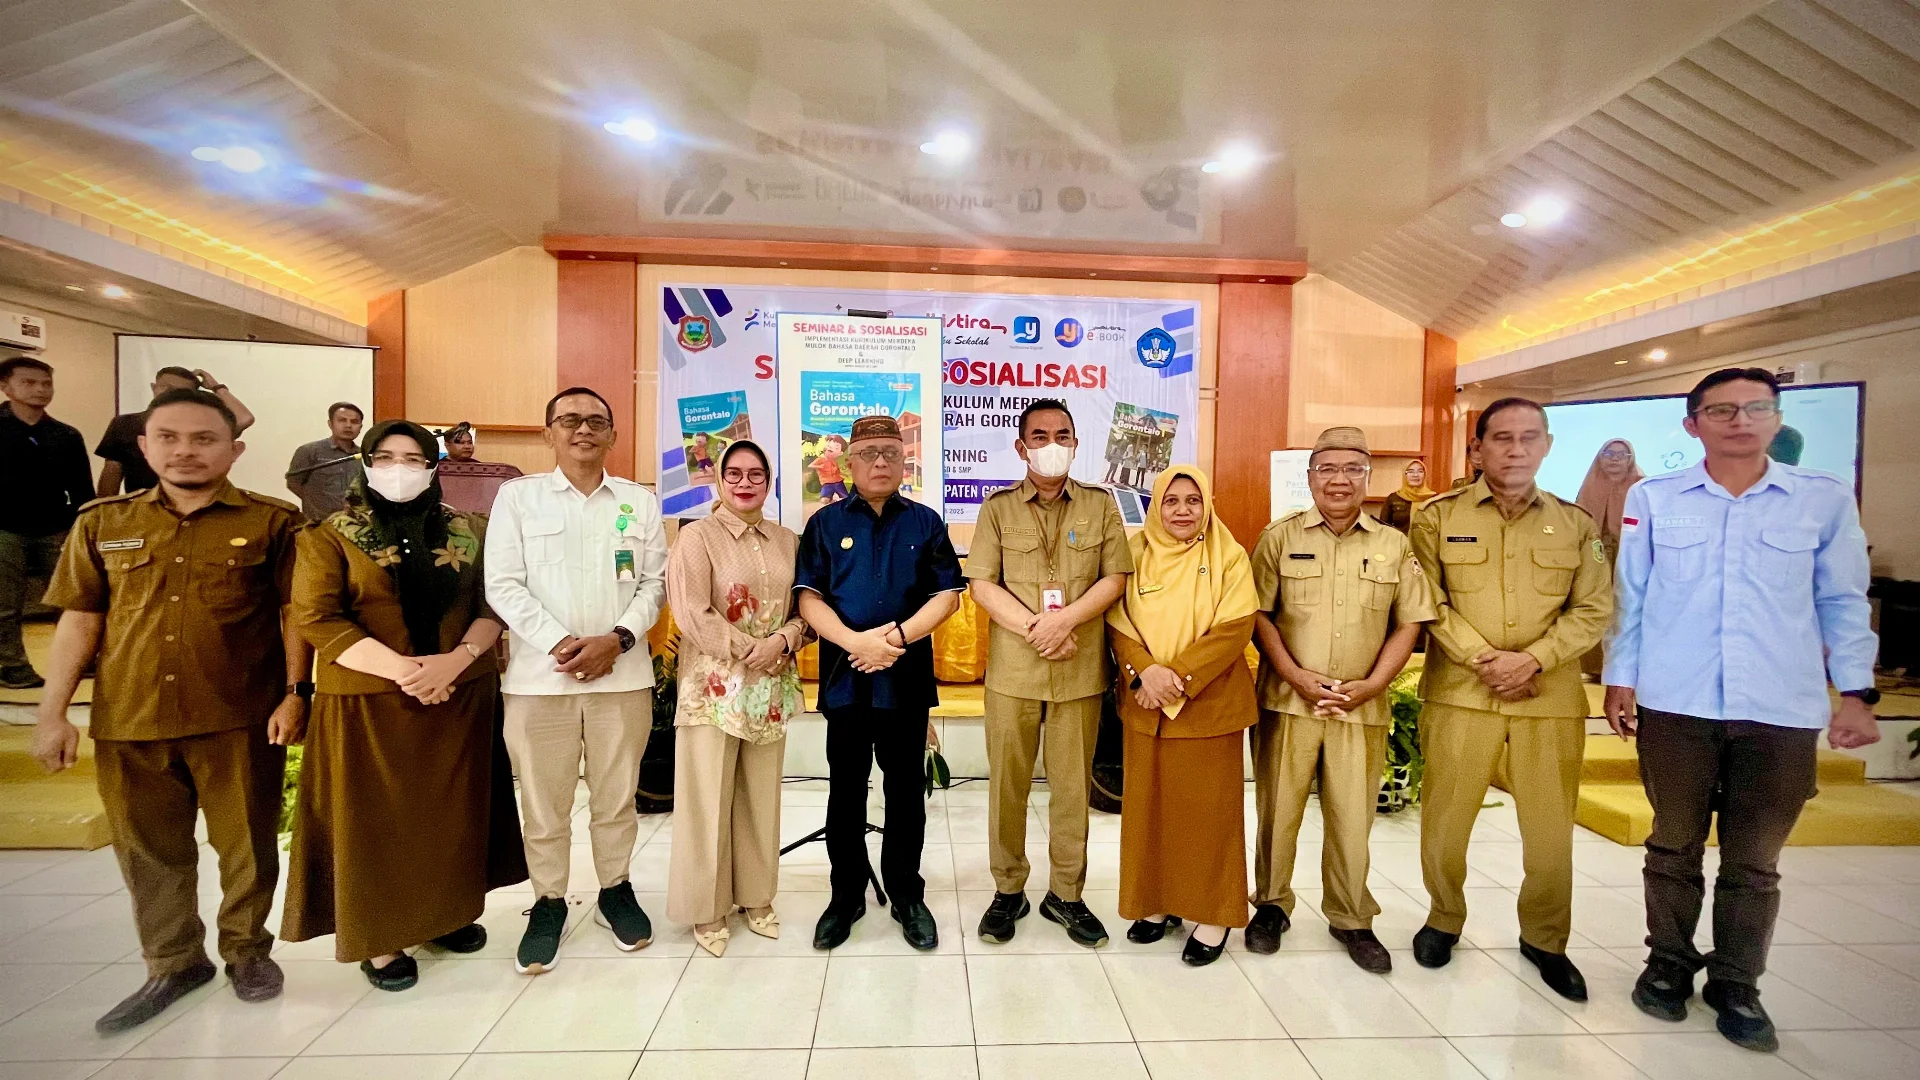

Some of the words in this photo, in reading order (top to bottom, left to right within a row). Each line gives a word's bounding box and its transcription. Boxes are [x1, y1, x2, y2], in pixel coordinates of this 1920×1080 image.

[793, 322, 845, 335] SEMINAR
[847, 324, 857, 335] &
[859, 324, 927, 336] SOSIALISASI
[804, 335, 849, 344] IMPLEMENTASI
[850, 336, 887, 344] KURIKULUM
[887, 337, 916, 345] MERDEKA
[954, 335, 990, 346] Sekolah
[880, 344, 916, 352] GORONTALO
[854, 357, 884, 365] LEARNING
[810, 389, 855, 402] Bahasa
[684, 406, 710, 415] Bahasa
[809, 402, 890, 416] Gorontalo
[684, 410, 731, 423] Gorontalo
[1117, 419, 1161, 437] Gorontalo
[952, 466, 957, 474] &
[958, 466, 972, 474] SMP
[944, 484, 978, 498] PATEN
